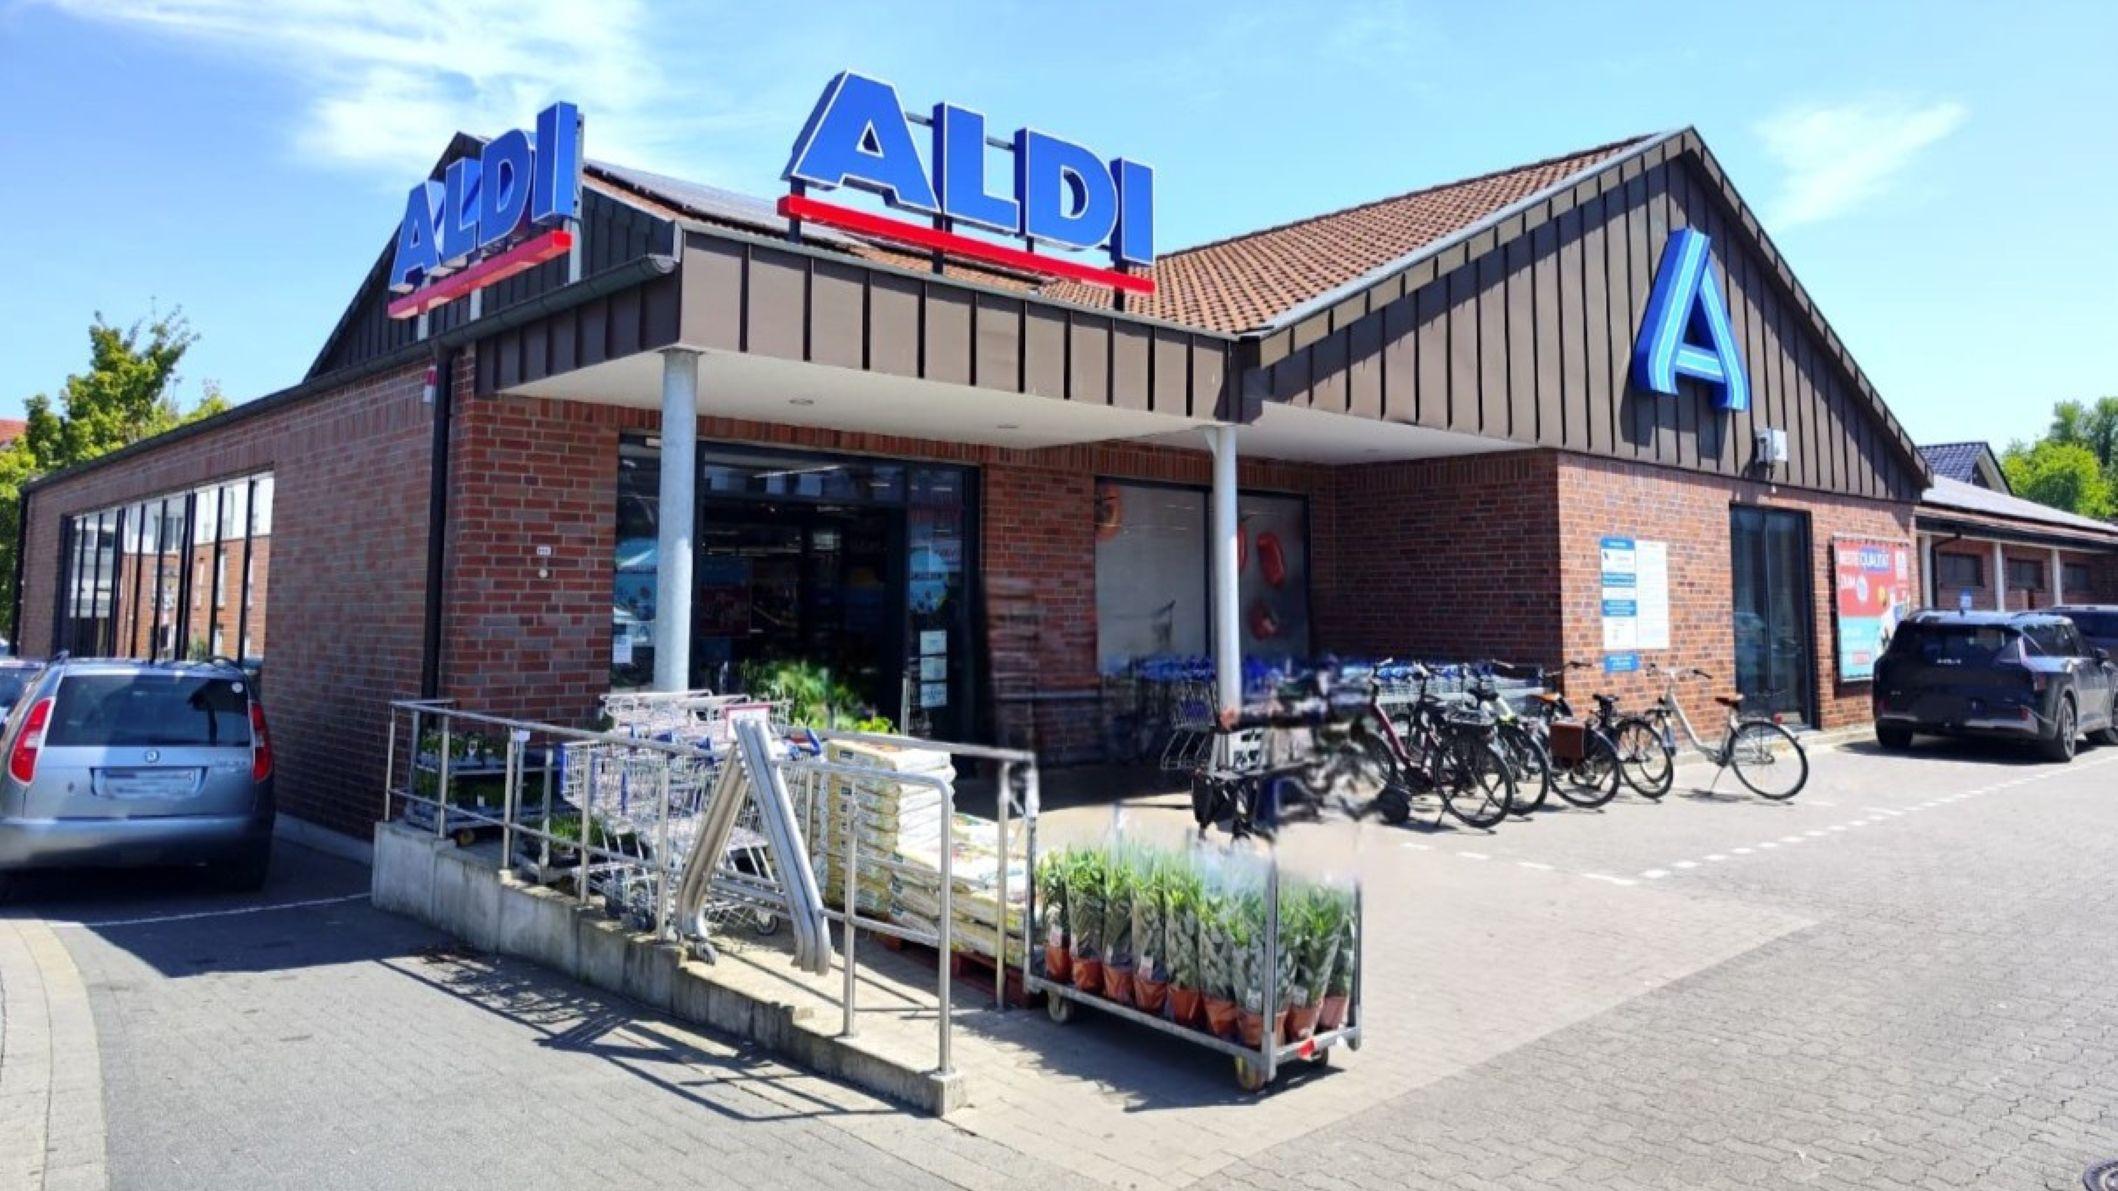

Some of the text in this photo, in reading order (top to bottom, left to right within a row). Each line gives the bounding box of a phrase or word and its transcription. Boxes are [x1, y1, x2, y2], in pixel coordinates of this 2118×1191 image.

[388, 101, 577, 292] ALDI
[781, 69, 1154, 265] ALDI
[1633, 226, 1749, 412] A
